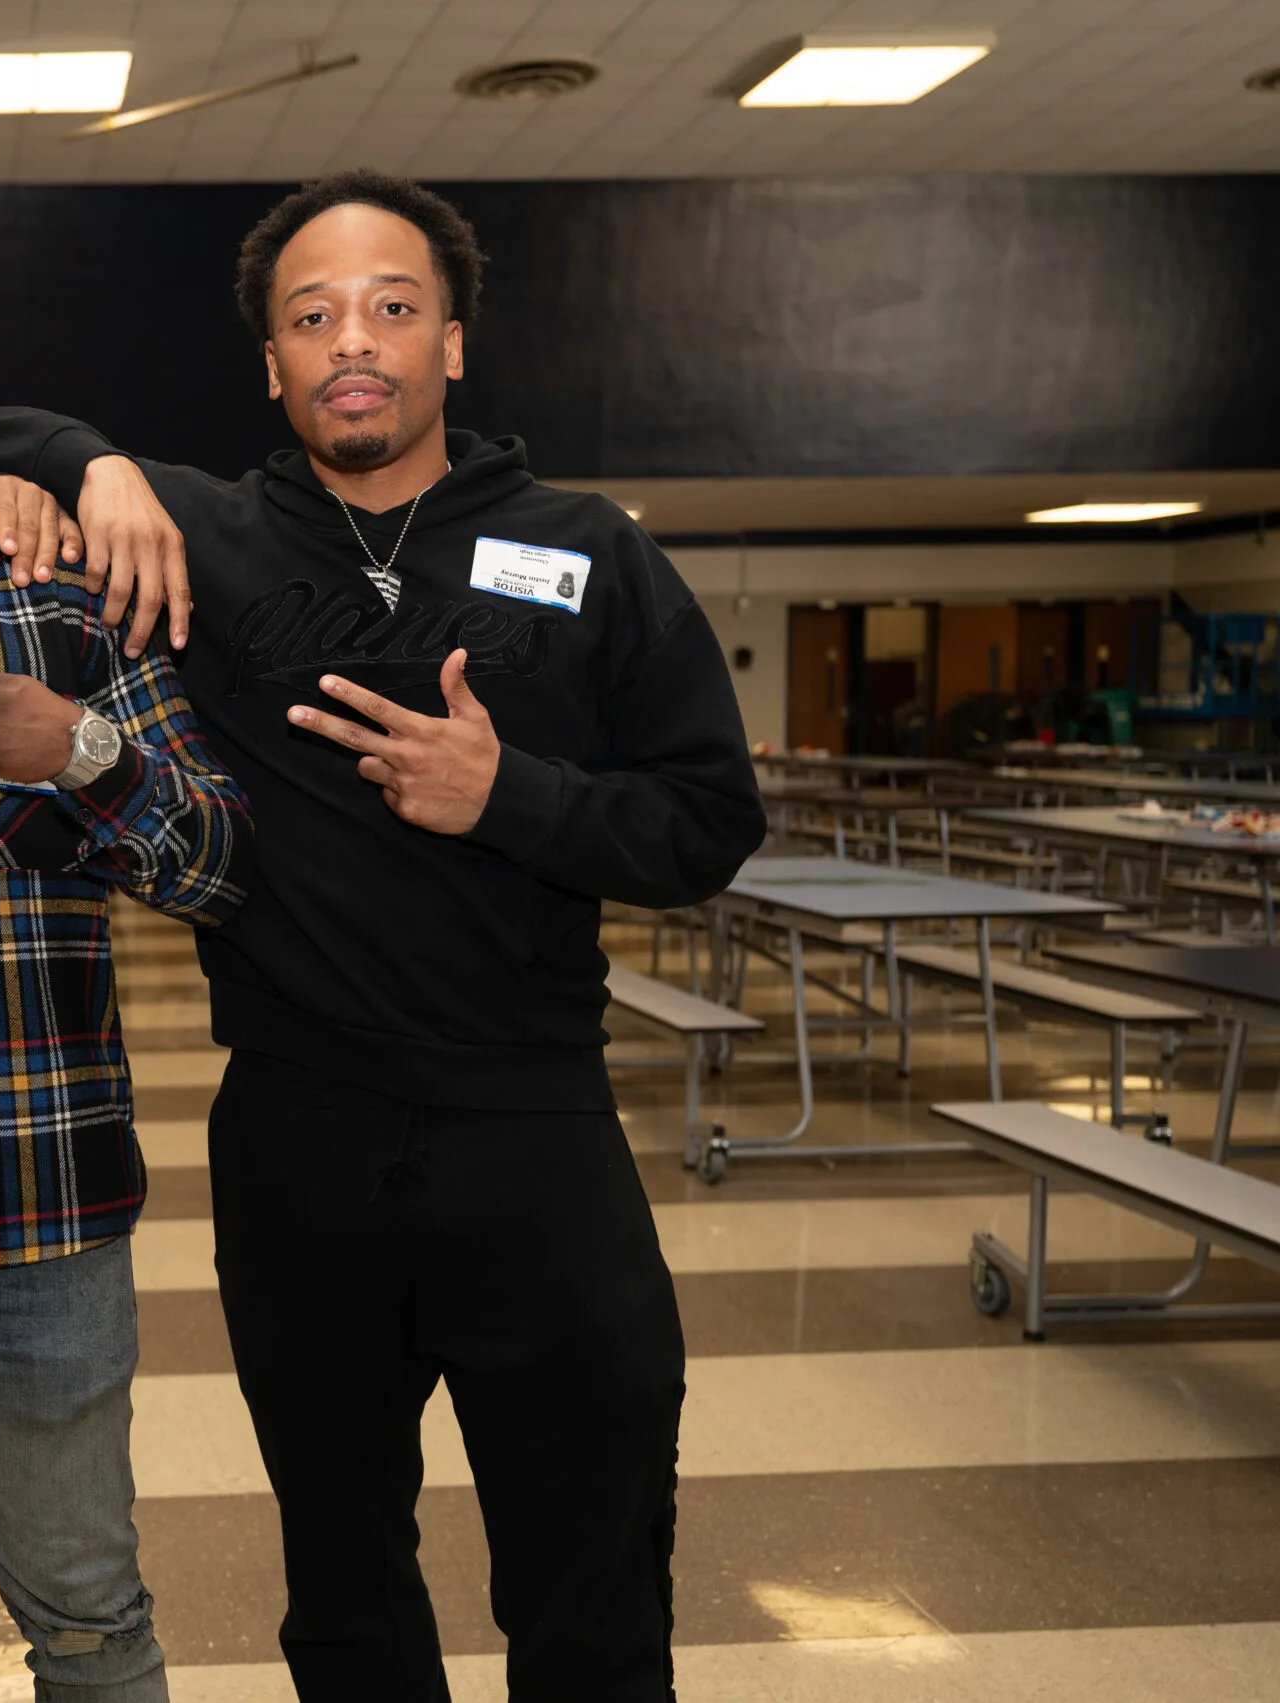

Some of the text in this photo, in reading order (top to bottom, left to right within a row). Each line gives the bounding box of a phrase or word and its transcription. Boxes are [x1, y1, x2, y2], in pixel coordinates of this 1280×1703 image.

[501, 569, 551, 585] Justin Murray
[493, 581, 535, 596] VISITOR
[223, 576, 561, 698] Planes
